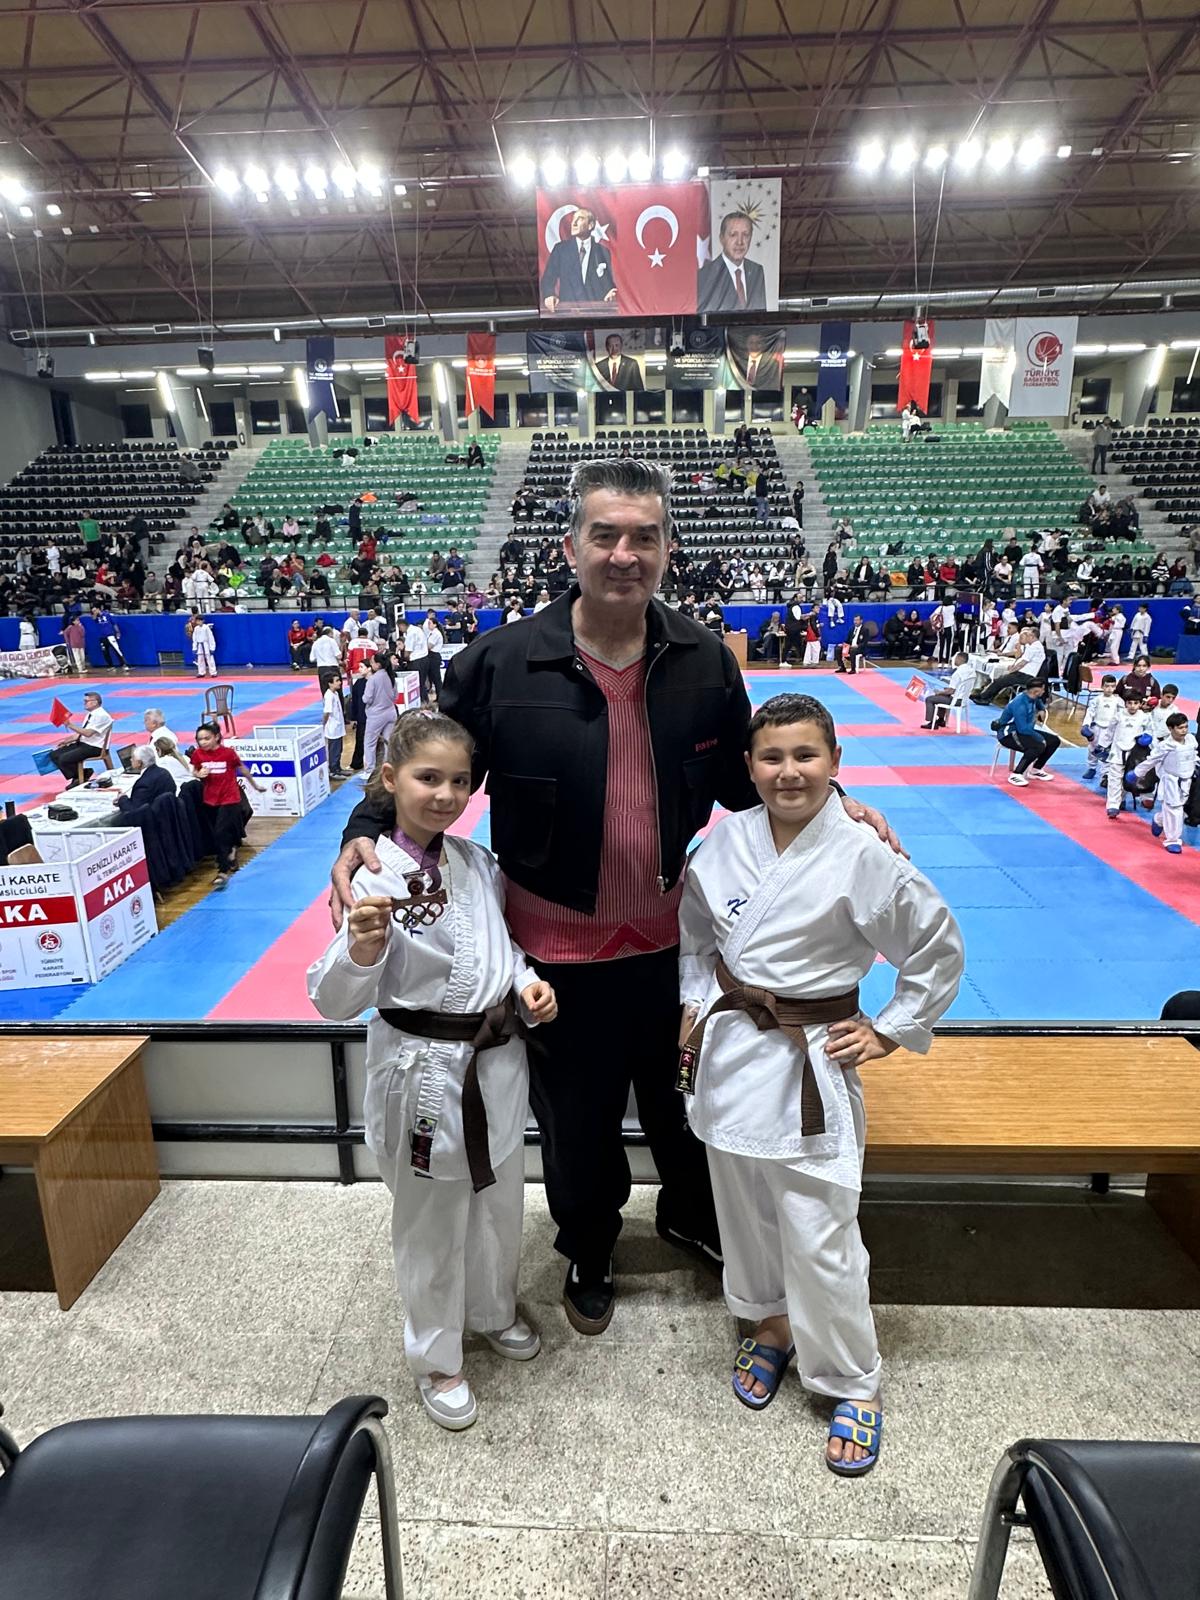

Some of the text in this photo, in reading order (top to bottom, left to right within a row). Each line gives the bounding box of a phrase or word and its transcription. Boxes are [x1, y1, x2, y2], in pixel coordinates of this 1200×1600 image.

[250, 762, 273, 775] AO
[87, 840, 138, 876] DENİZLİ KARATE
[9, 873, 61, 886] KARATE
[103, 873, 135, 906] AKA
[0, 903, 49, 924] KA
